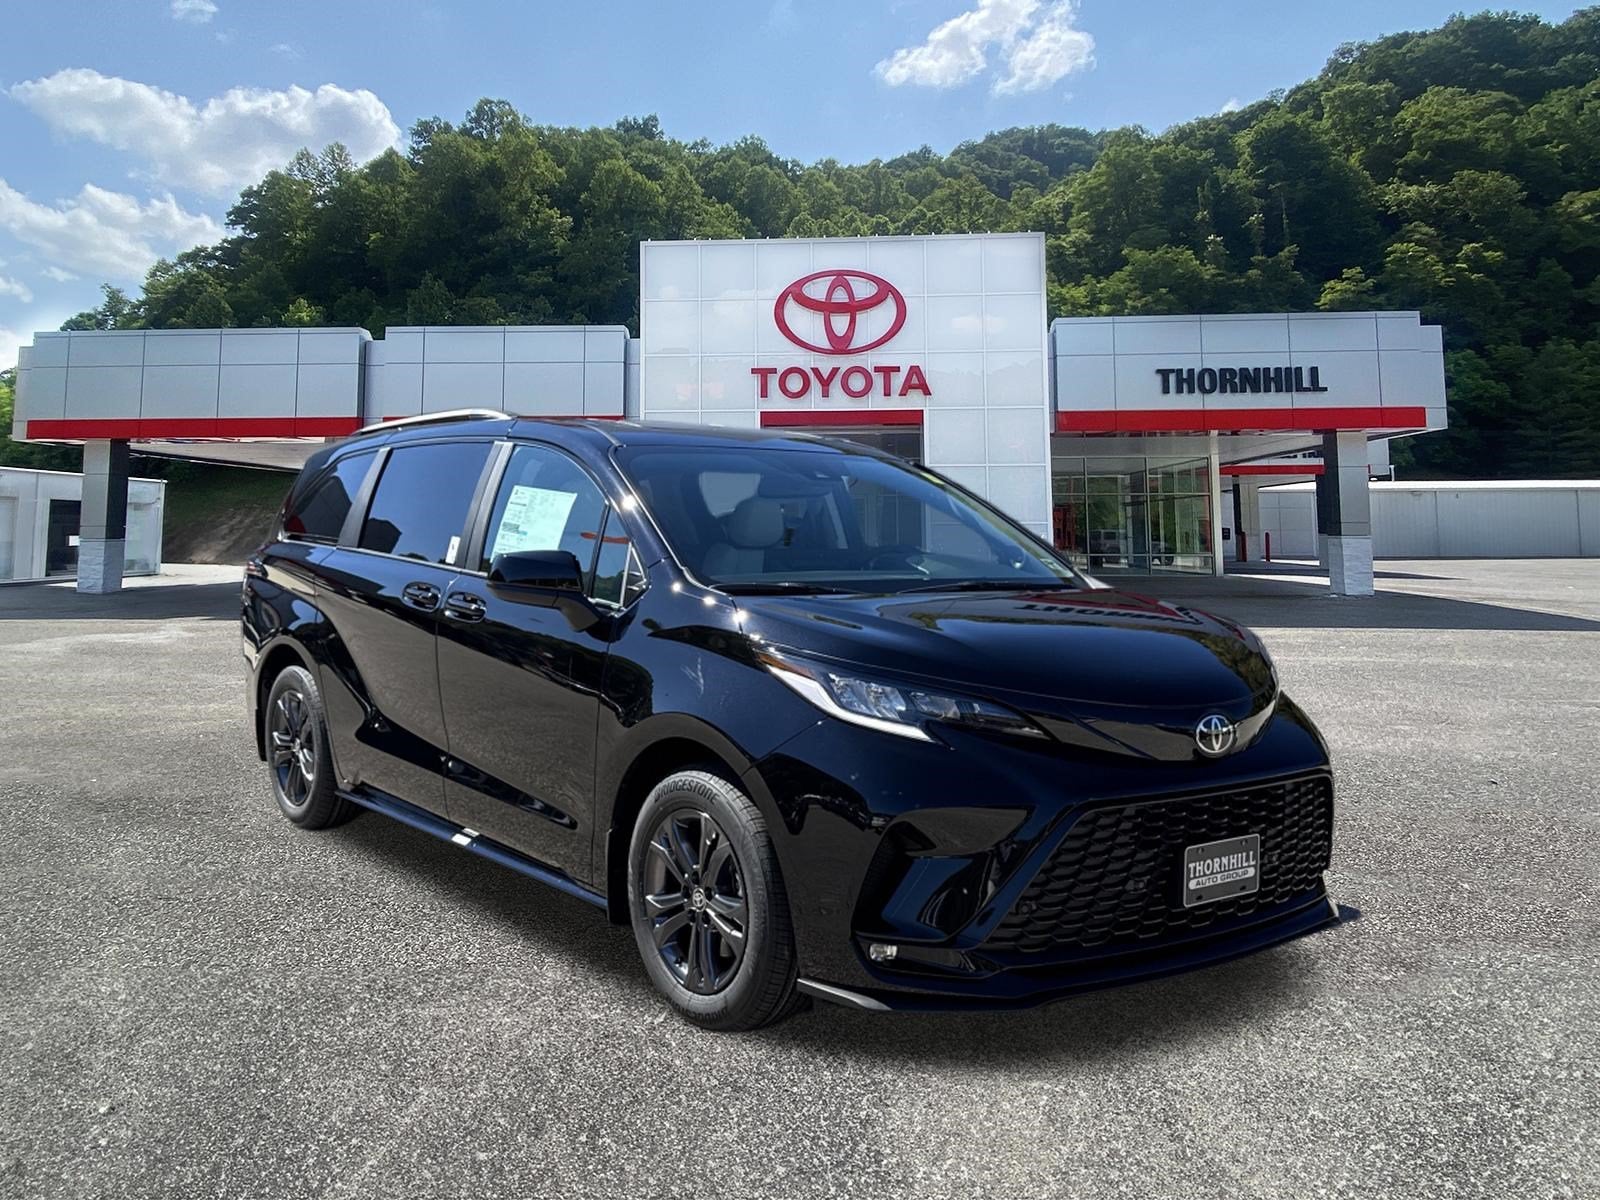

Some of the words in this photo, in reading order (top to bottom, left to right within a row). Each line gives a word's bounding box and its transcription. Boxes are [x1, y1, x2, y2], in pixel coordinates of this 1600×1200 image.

[751, 366, 932, 399] TOYOTA
[1156, 366, 1328, 394] THORNHILL
[1188, 850, 1256, 878] THORNHILL
[1195, 876, 1218, 887] AUTO
[1220, 869, 1249, 881] GROUP
